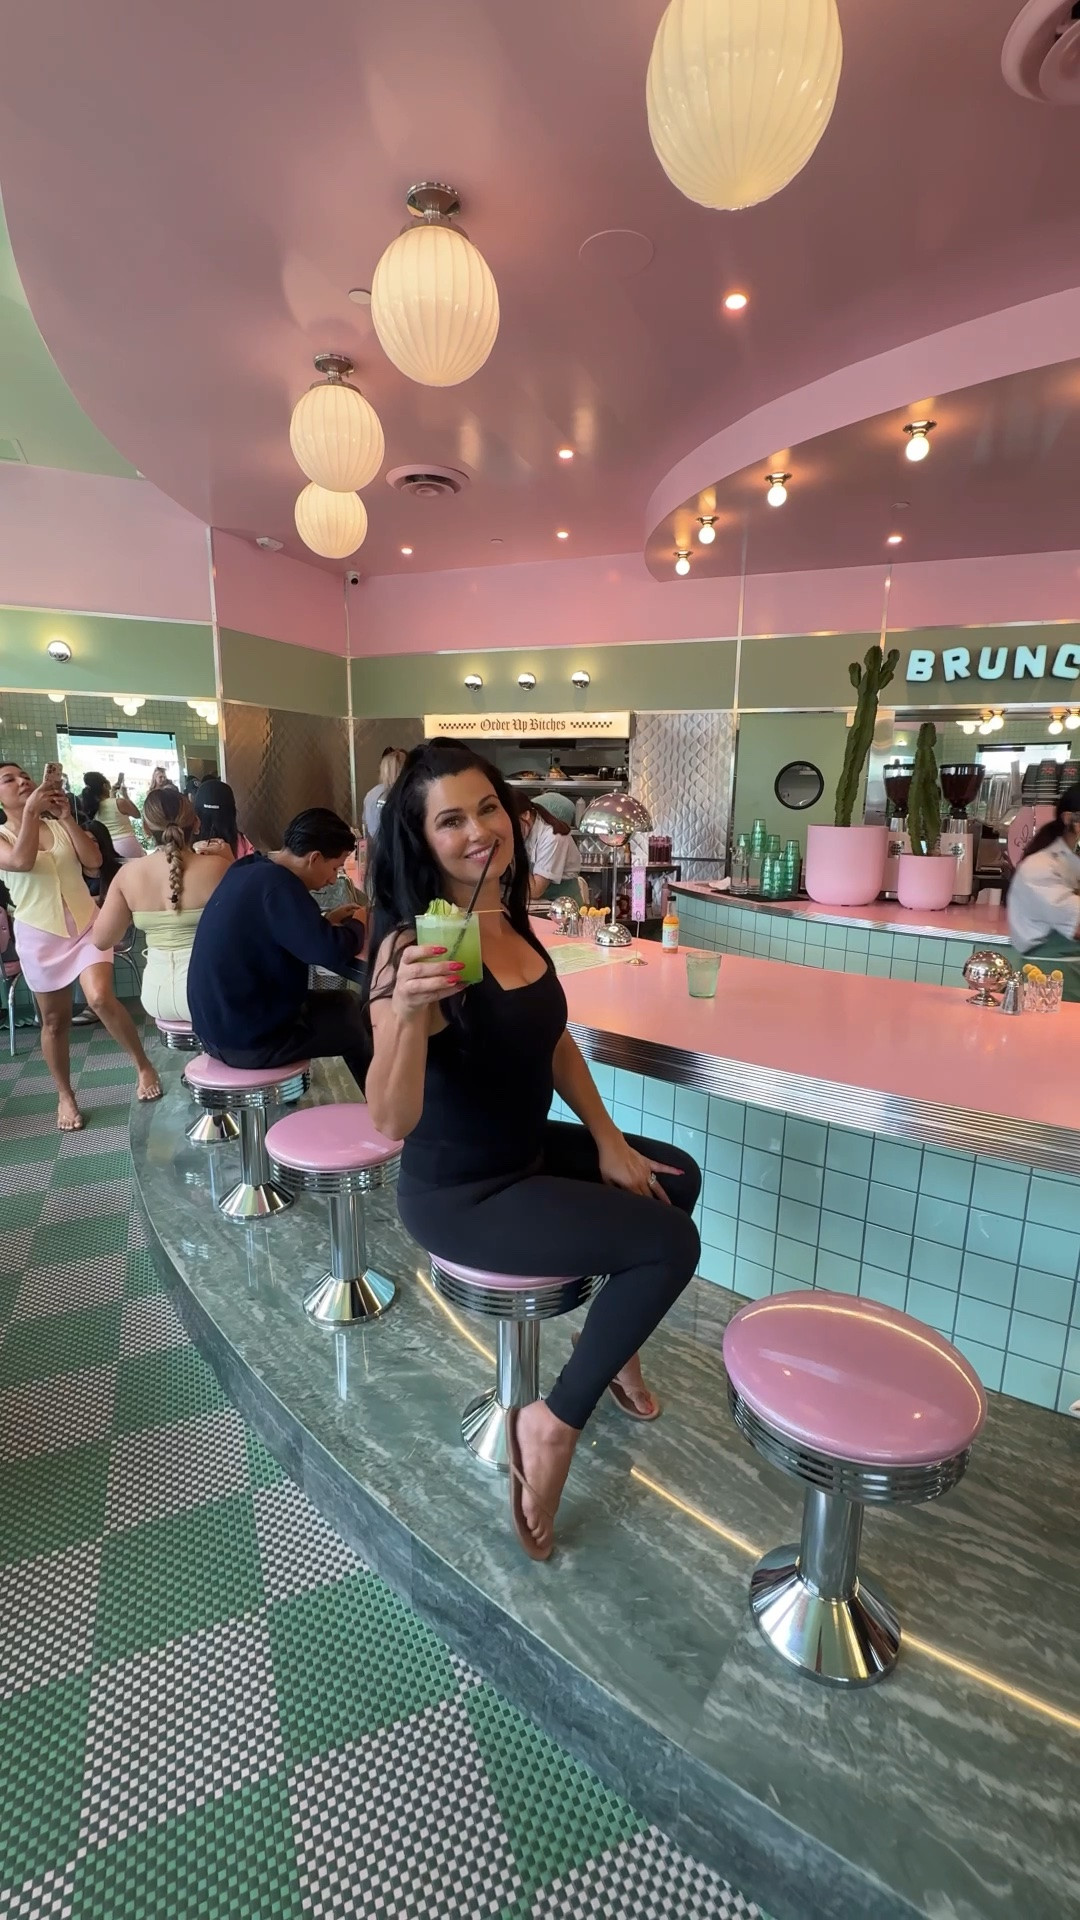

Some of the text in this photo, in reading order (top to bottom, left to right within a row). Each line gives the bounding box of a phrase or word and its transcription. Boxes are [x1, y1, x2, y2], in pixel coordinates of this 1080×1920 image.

[906, 643, 1080, 683] BRUNC
[480, 717, 566, 733] Order Up Bitches
